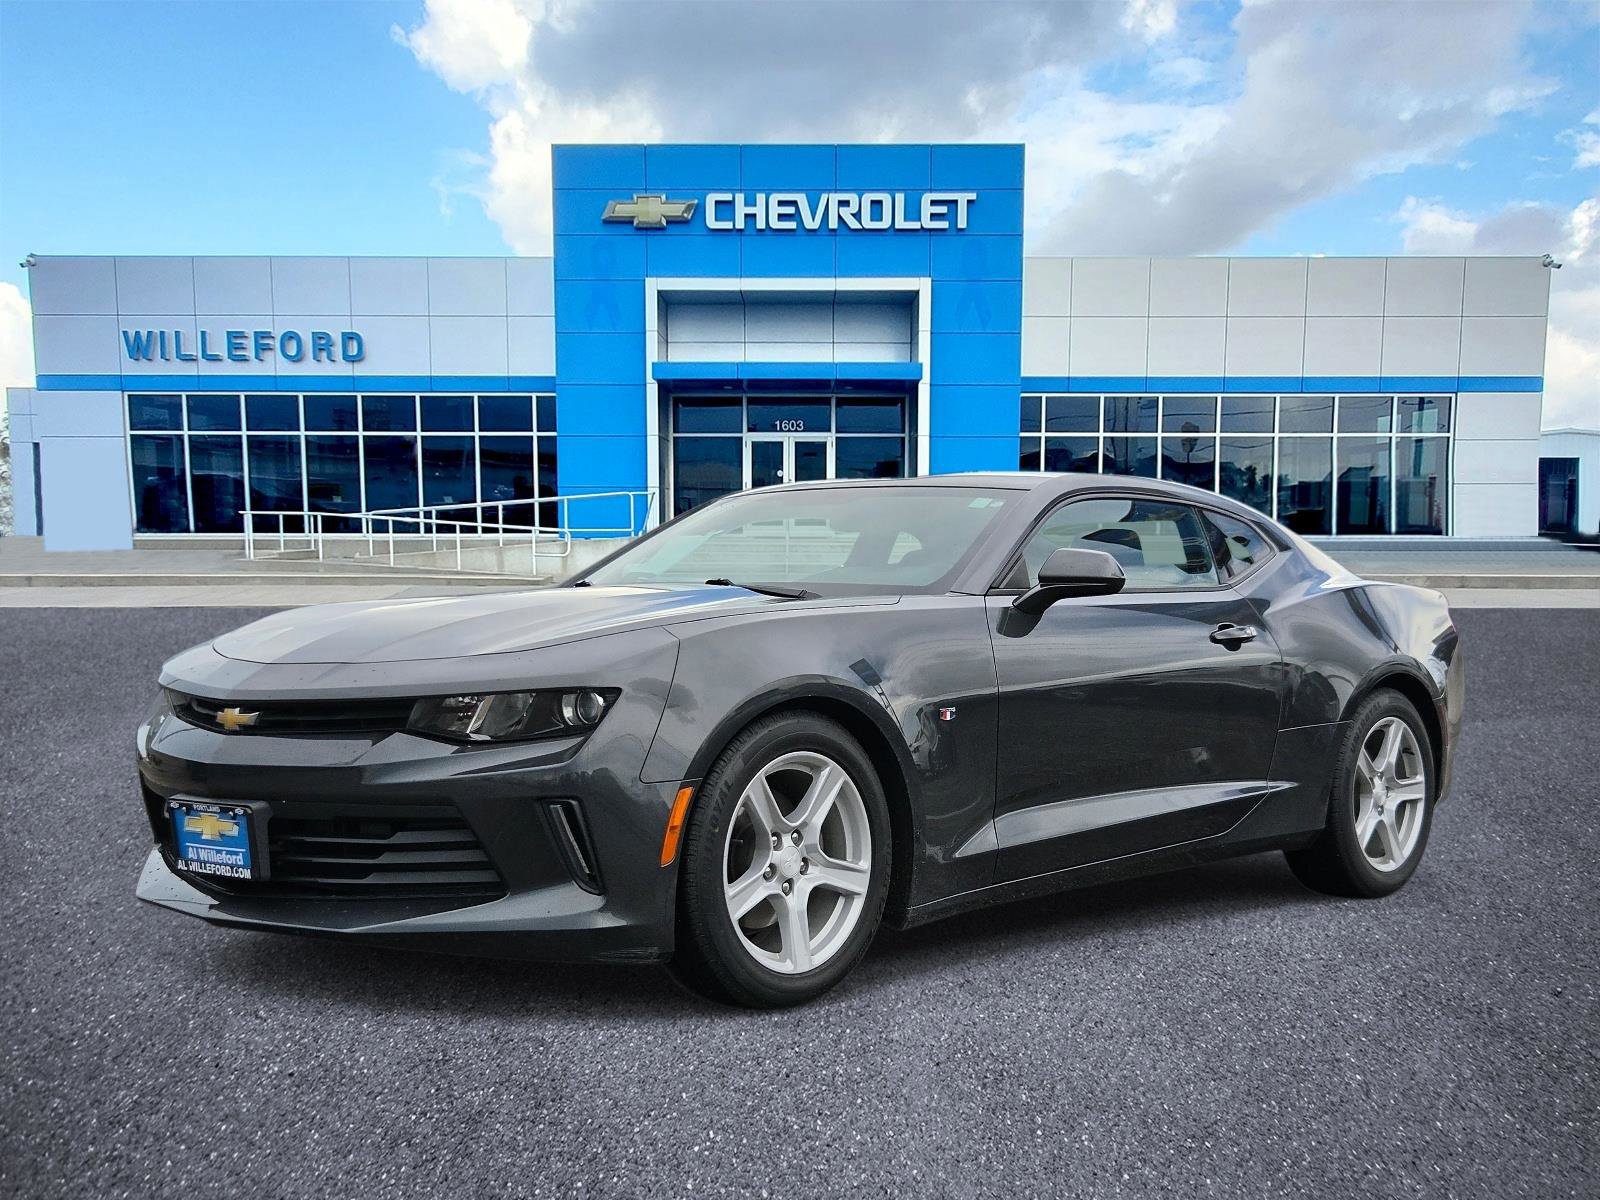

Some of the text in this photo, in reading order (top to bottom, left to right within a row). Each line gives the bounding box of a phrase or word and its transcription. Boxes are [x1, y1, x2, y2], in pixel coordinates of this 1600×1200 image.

[705, 193, 977, 230] CHEVROLET
[122, 330, 366, 362] WILLEFORD
[774, 419, 804, 431] 1603
[188, 847, 244, 865] Al Willeford
[178, 860, 252, 879] AL WILLEFORD.COM
